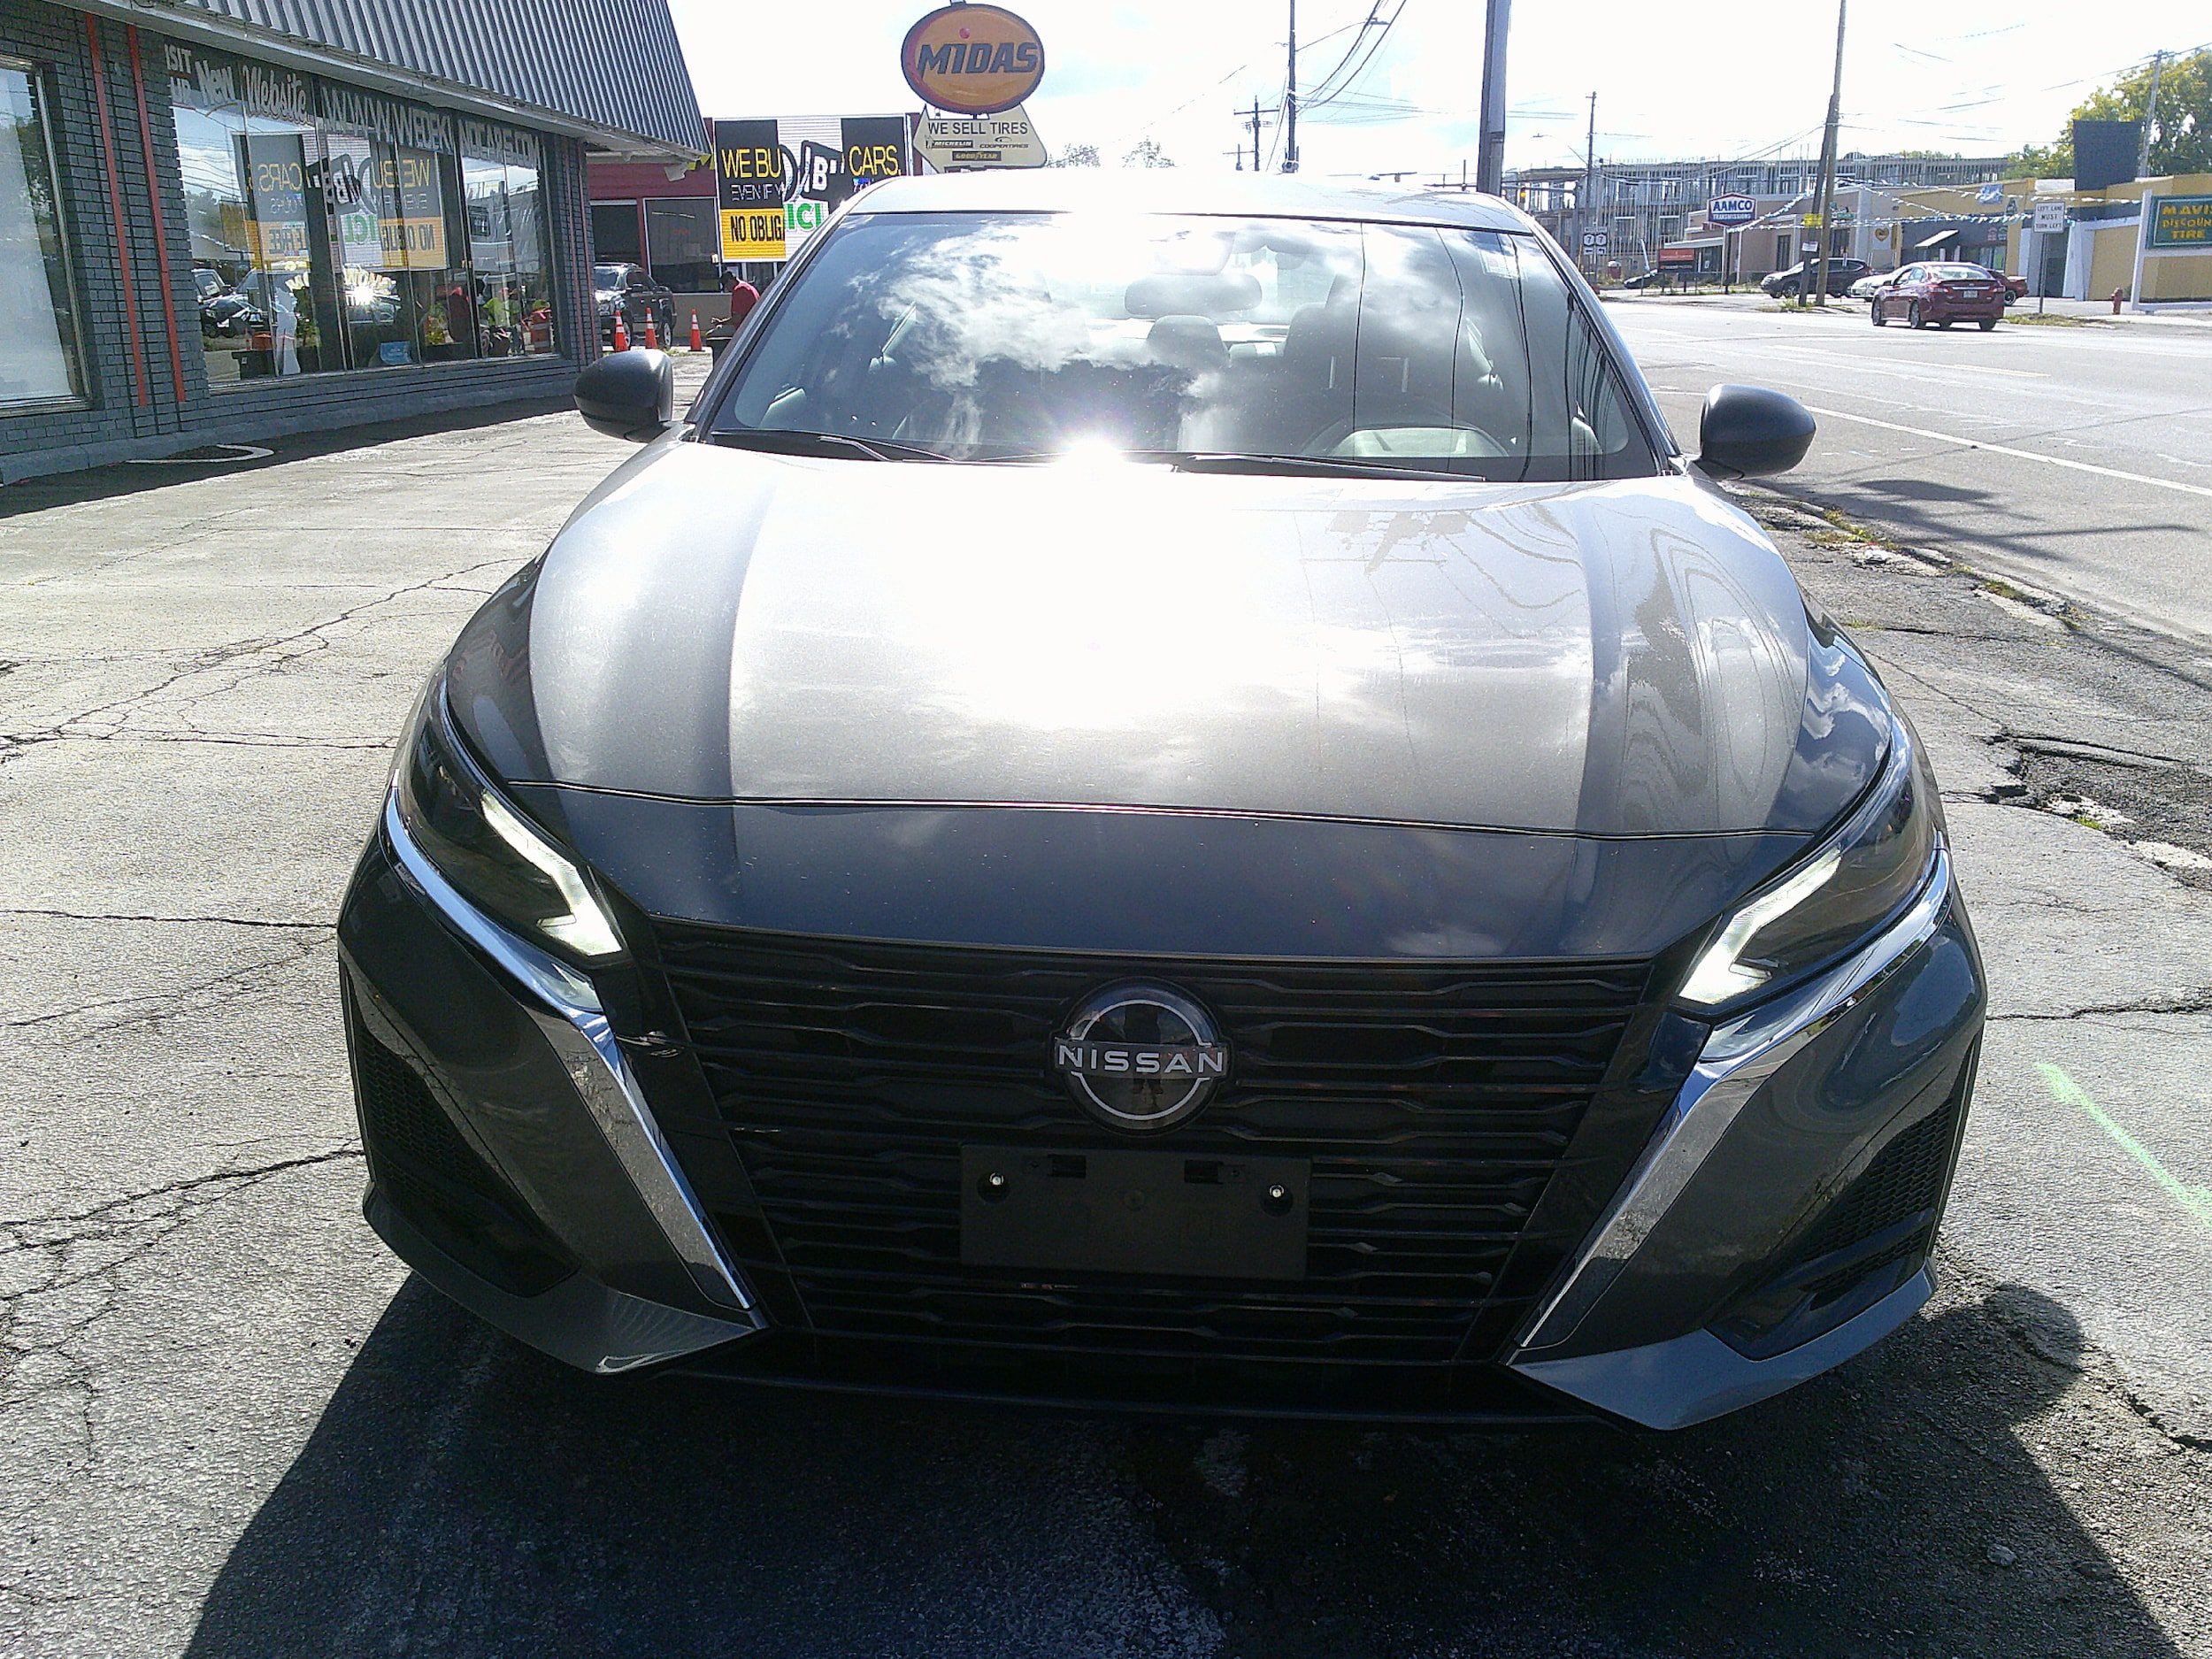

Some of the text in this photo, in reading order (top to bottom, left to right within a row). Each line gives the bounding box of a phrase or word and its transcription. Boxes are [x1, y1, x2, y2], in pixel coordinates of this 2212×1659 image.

[165, 44, 192, 73] ISIT
[917, 42, 1039, 80] MIDAS
[196, 59, 237, 106] New
[242, 65, 311, 125] Website
[928, 121, 1028, 134] WE SELL TIRES
[721, 149, 752, 178] WE
[1713, 200, 1753, 211] AAMCO
[730, 215, 747, 242] NO
[2162, 217, 2212, 228] DISCOUN
[2170, 229, 2206, 240] TIRE
[1058, 1045, 1223, 1074] NISSAN
